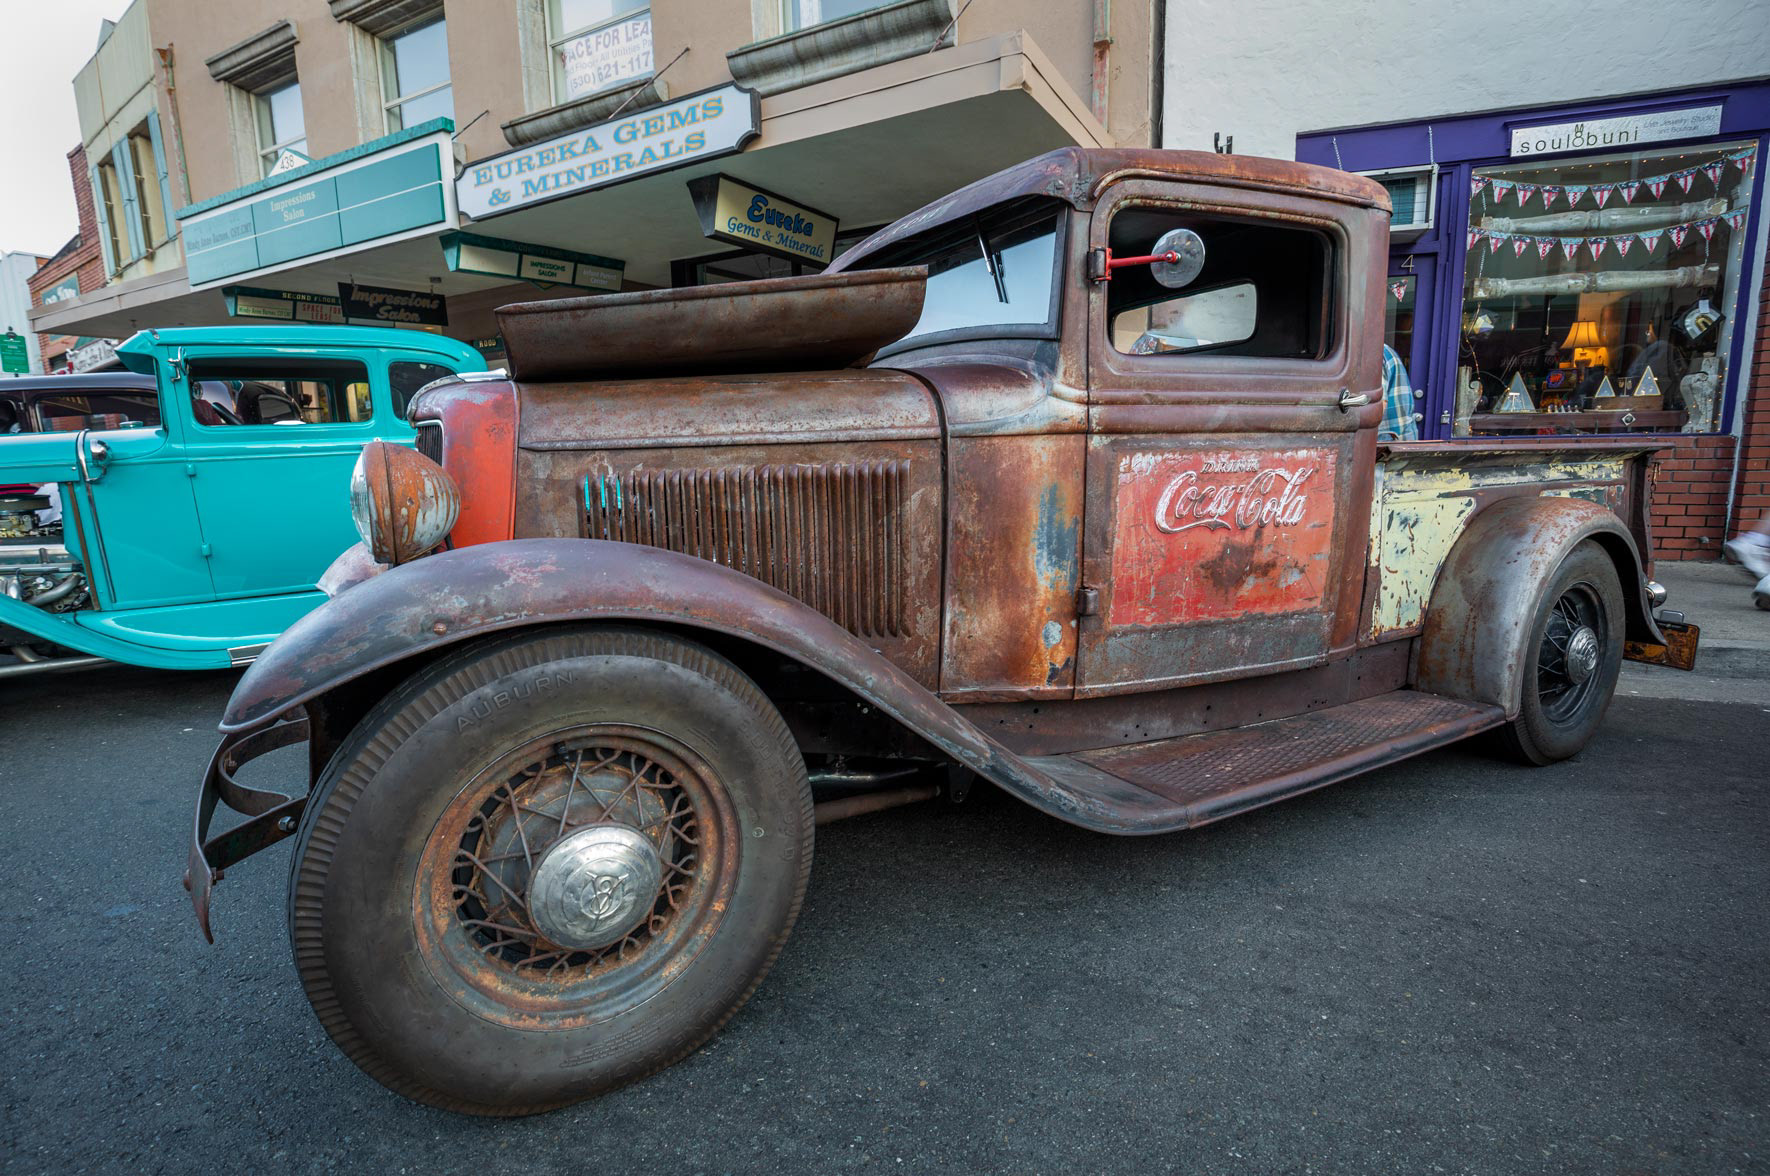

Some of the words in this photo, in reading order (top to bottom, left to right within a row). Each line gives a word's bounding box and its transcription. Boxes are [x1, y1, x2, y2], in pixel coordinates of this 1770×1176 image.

[595, 28, 620, 52] FOR
[625, 21, 650, 42] LEA
[612, 45, 640, 58] Utilities
[597, 51, 650, 81] 621-117
[473, 134, 603, 188] EUREKA
[613, 95, 724, 146] GEMS
[280, 155, 294, 170] 438
[488, 187, 511, 207] &
[522, 131, 707, 198] MINERALS
[270, 190, 316, 212] Impressions
[283, 208, 304, 222] Salon
[747, 194, 814, 237] Eureka
[728, 216, 761, 239] Gems
[762, 230, 774, 242] &
[776, 232, 824, 258] Minerals
[530, 261, 566, 272] IMPRESSIONS
[538, 269, 557, 278] SALON
[282, 292, 312, 302] SECOND
[314, 295, 336, 304] FLOOR
[351, 286, 440, 310] Impressions
[302, 304, 324, 313] SPACE
[311, 312, 333, 321] LEASE
[376, 306, 421, 322] Salon
[1200, 459, 1259, 474] DRINK
[457, 671, 574, 733] AUBURN
